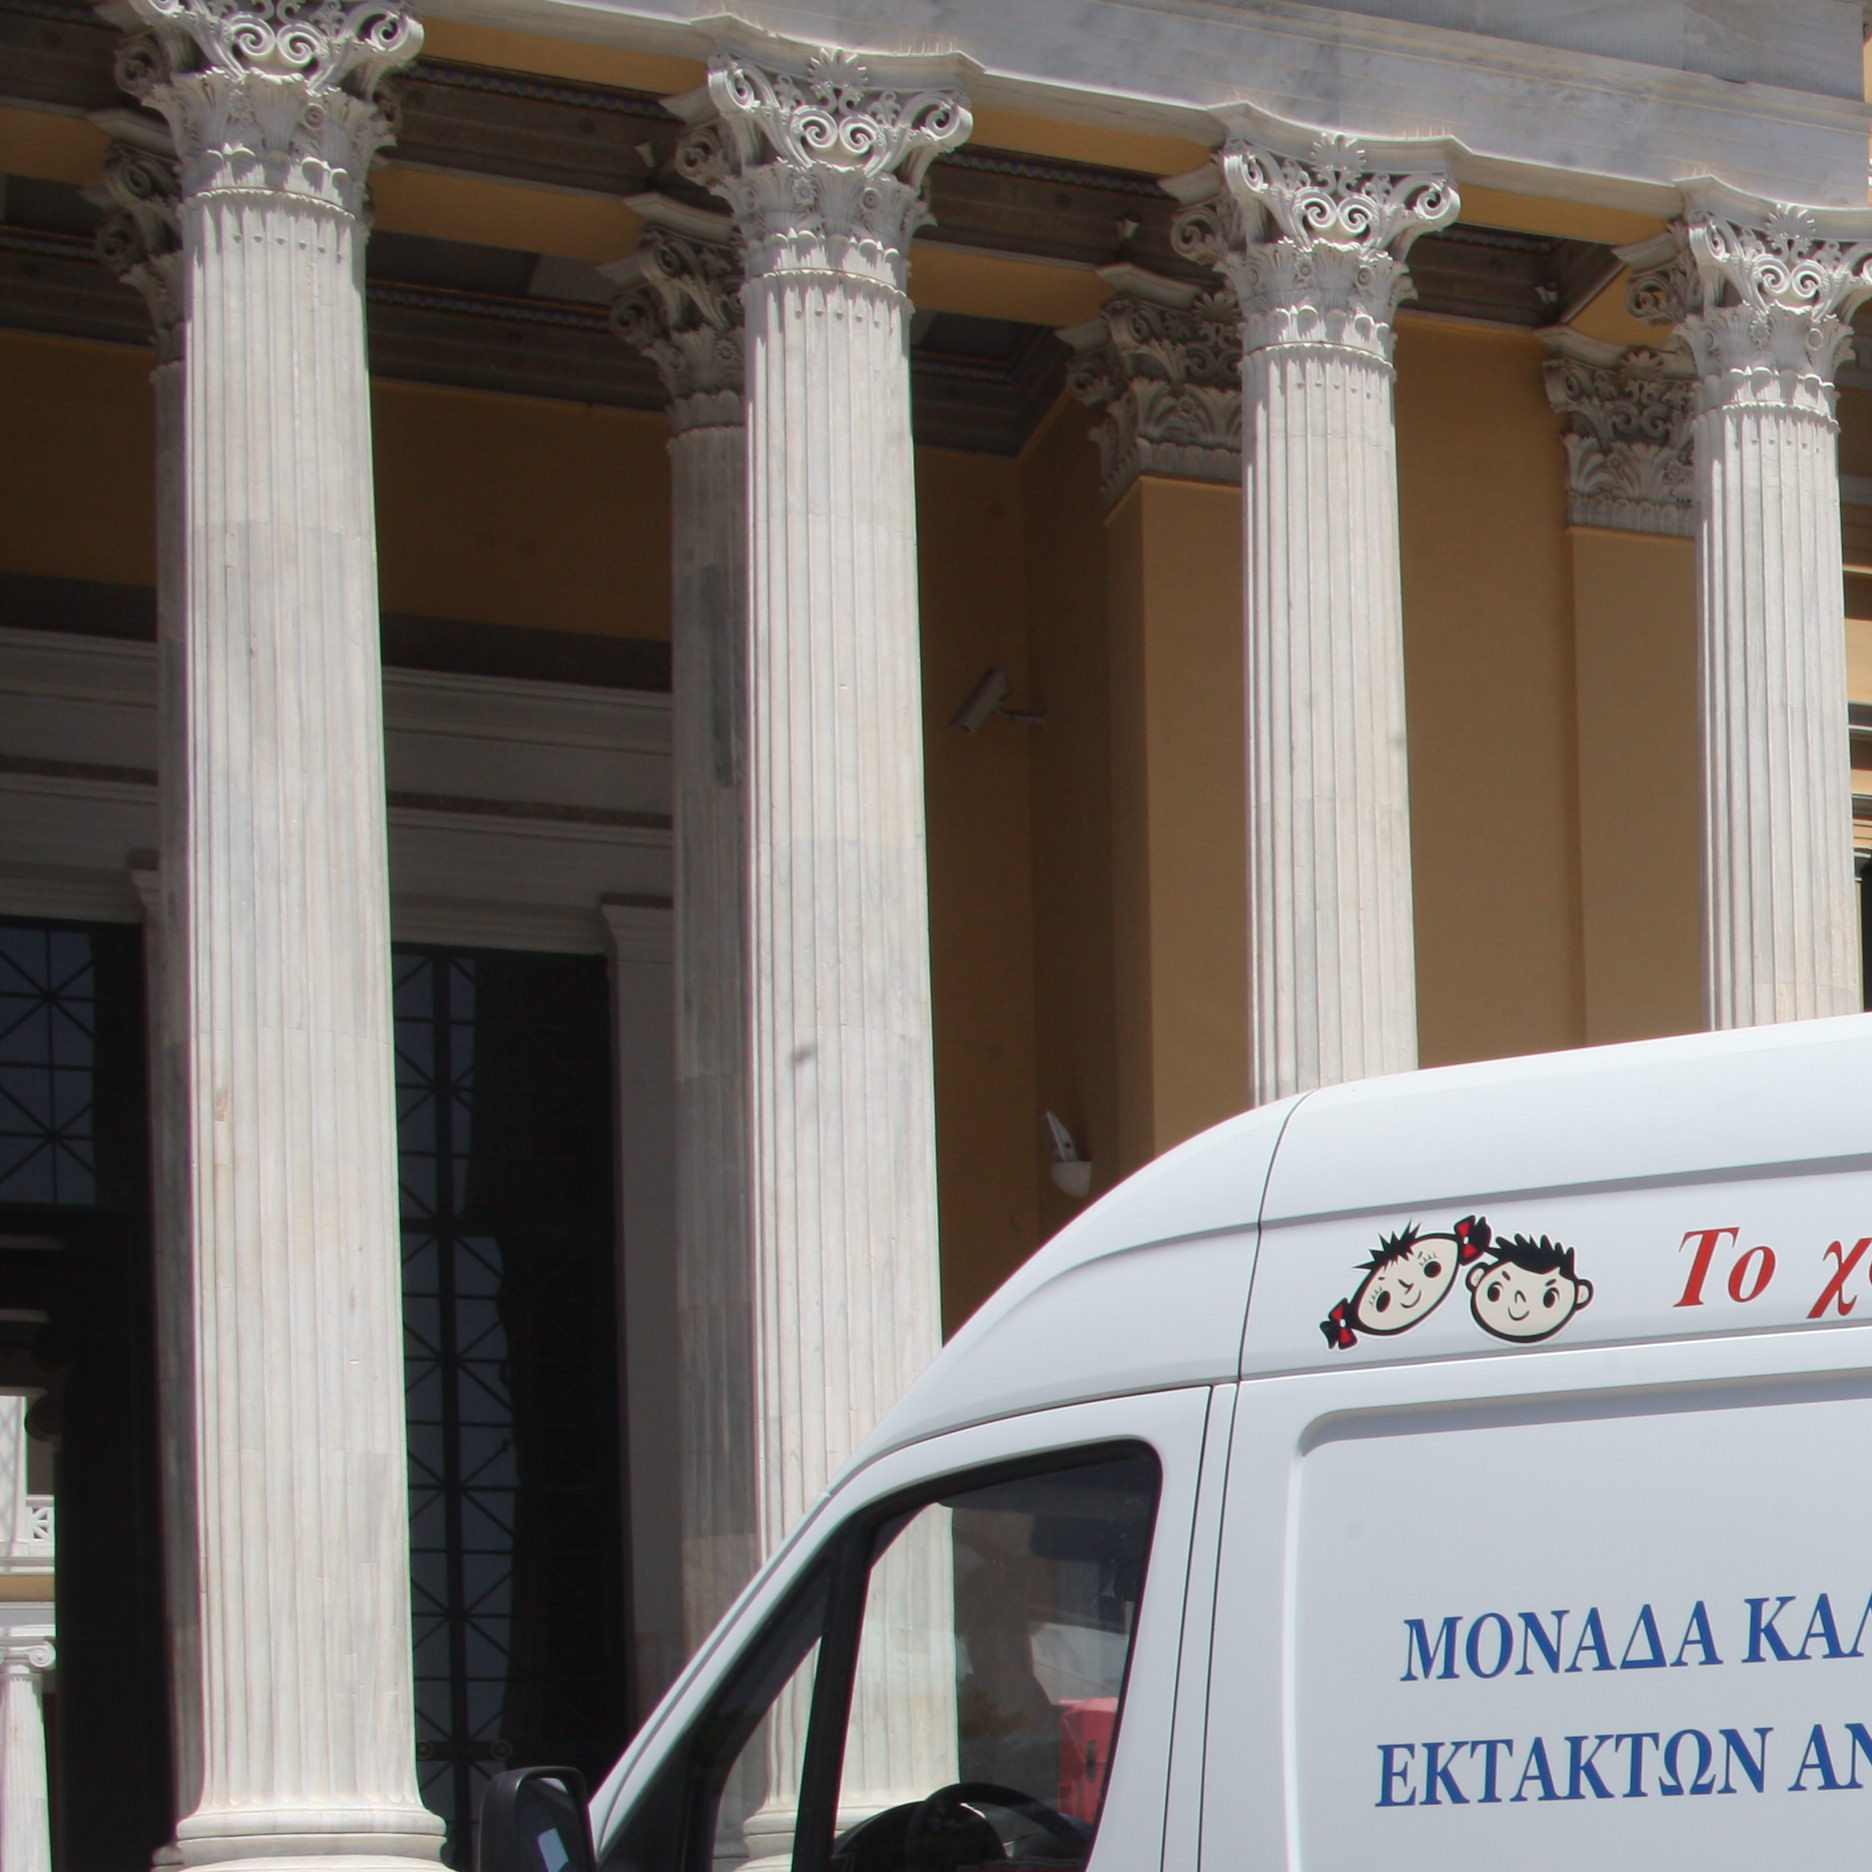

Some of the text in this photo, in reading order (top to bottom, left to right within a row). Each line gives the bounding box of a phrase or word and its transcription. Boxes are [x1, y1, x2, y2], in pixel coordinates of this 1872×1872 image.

[1673, 1226, 1776, 1308] Το
[1400, 1601, 1724, 1682] ΜΟΝΑΔΑ
[1374, 1726, 1775, 1809] ΕΚΤΑΚΤΩΝ
